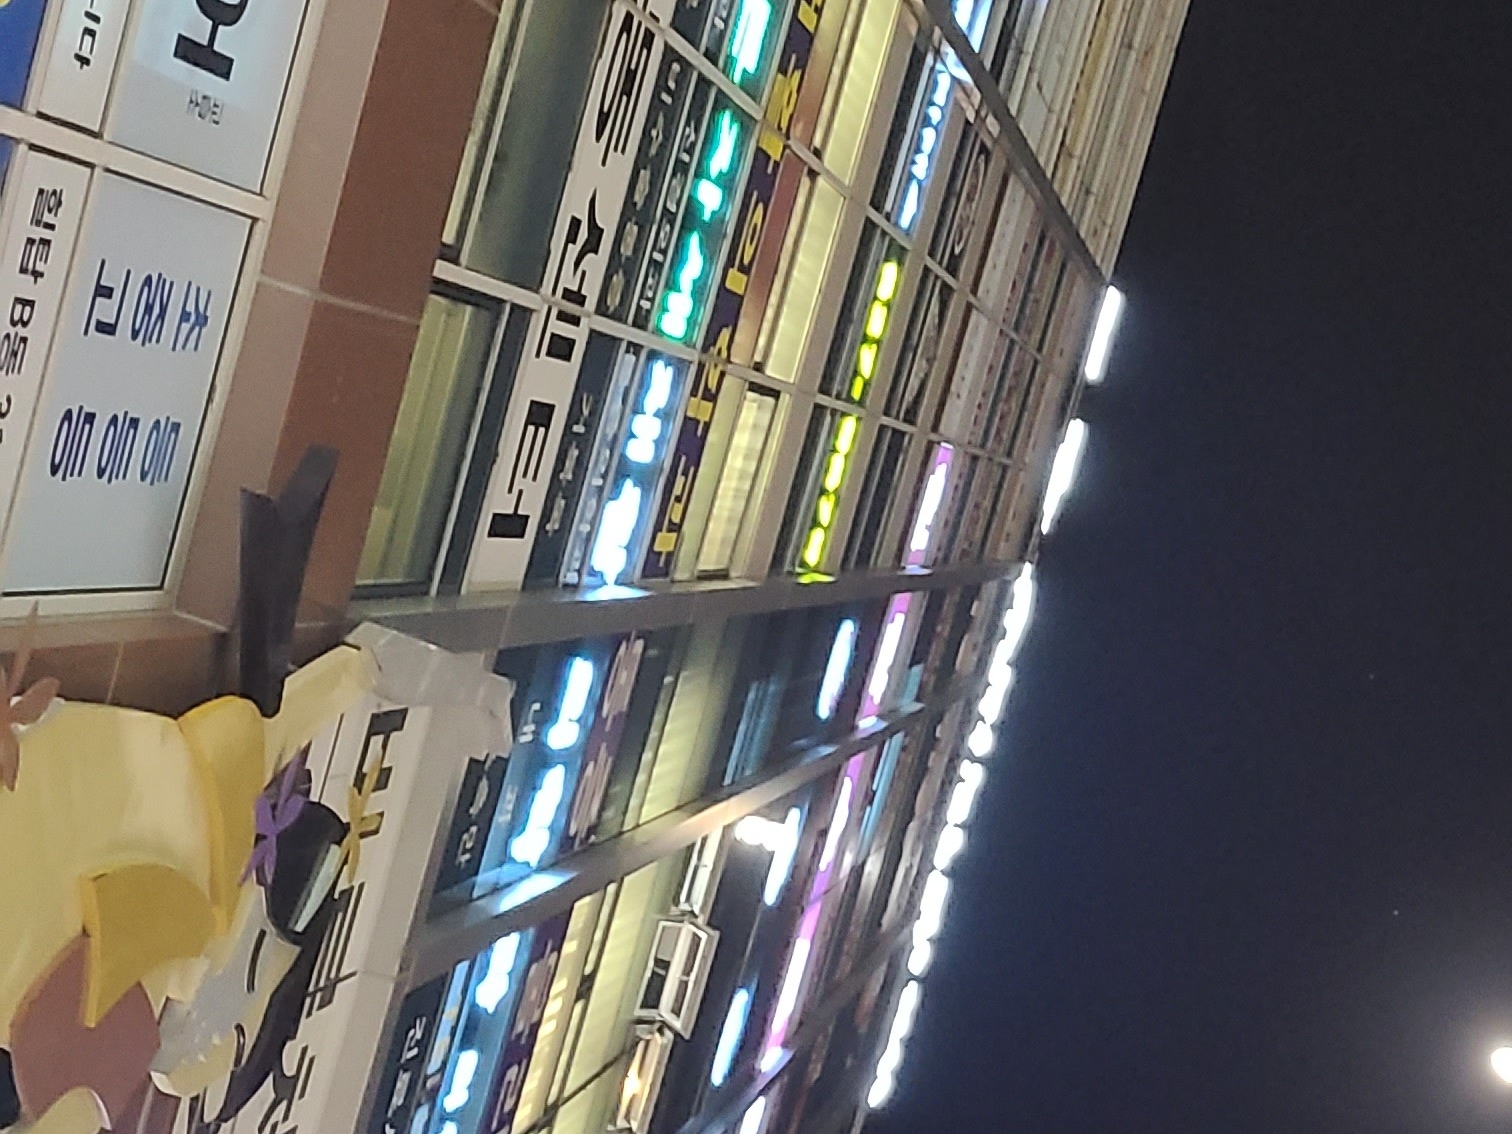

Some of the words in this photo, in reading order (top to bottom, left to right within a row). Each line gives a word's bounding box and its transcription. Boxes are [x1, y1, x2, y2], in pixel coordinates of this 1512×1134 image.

[17, 186, 65, 286] 힐탑
[487, 8, 657, 540] 동센터
[0, 297, 36, 377] B동
[83, 258, 212, 353] 초중고
[49, 404, 182, 487] 등등등
